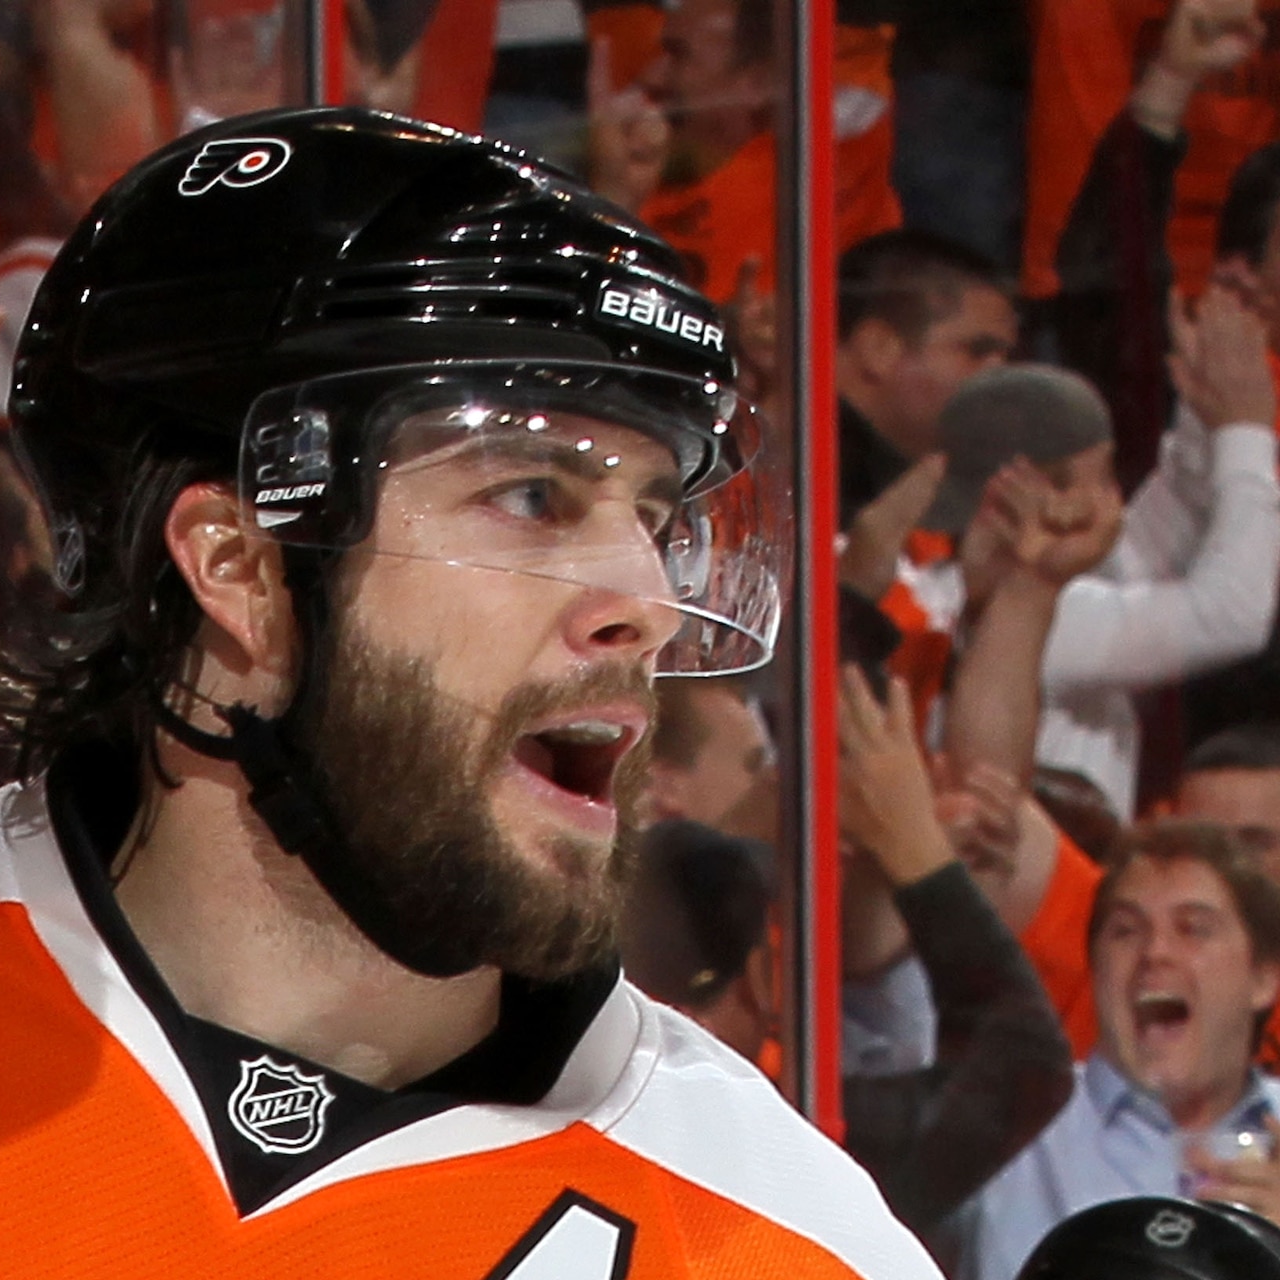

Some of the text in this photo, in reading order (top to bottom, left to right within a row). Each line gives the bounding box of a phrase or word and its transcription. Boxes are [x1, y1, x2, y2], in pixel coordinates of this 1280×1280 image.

[601, 289, 725, 353] BAUER
[255, 483, 326, 504] BAUER
[248, 1093, 311, 1123] NHL
